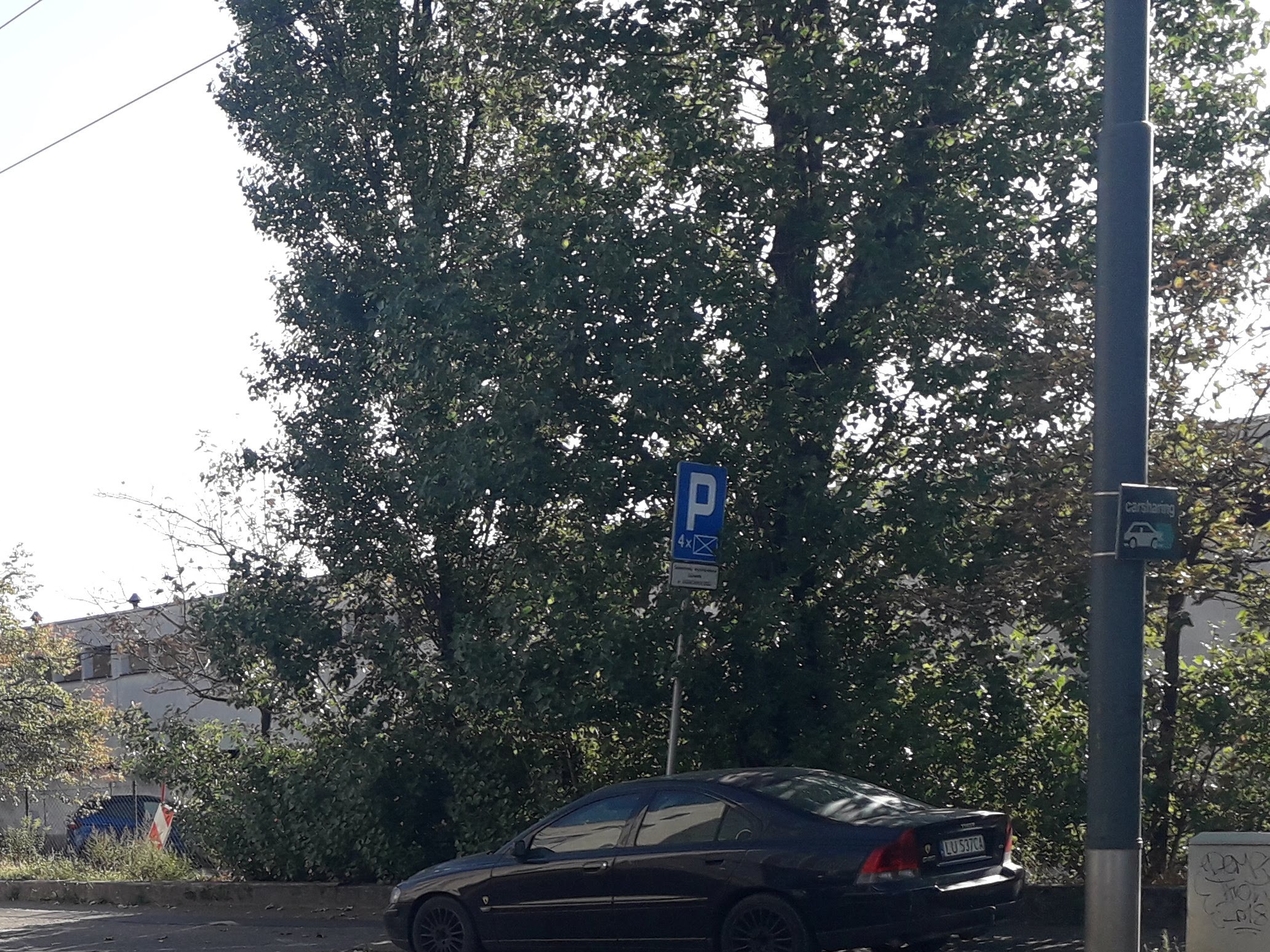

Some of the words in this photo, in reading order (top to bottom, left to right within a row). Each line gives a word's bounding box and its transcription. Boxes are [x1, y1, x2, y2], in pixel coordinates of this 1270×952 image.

[686, 472, 716, 531] P
[1125, 500, 1175, 517] carsharing
[944, 840, 958, 855] LU
